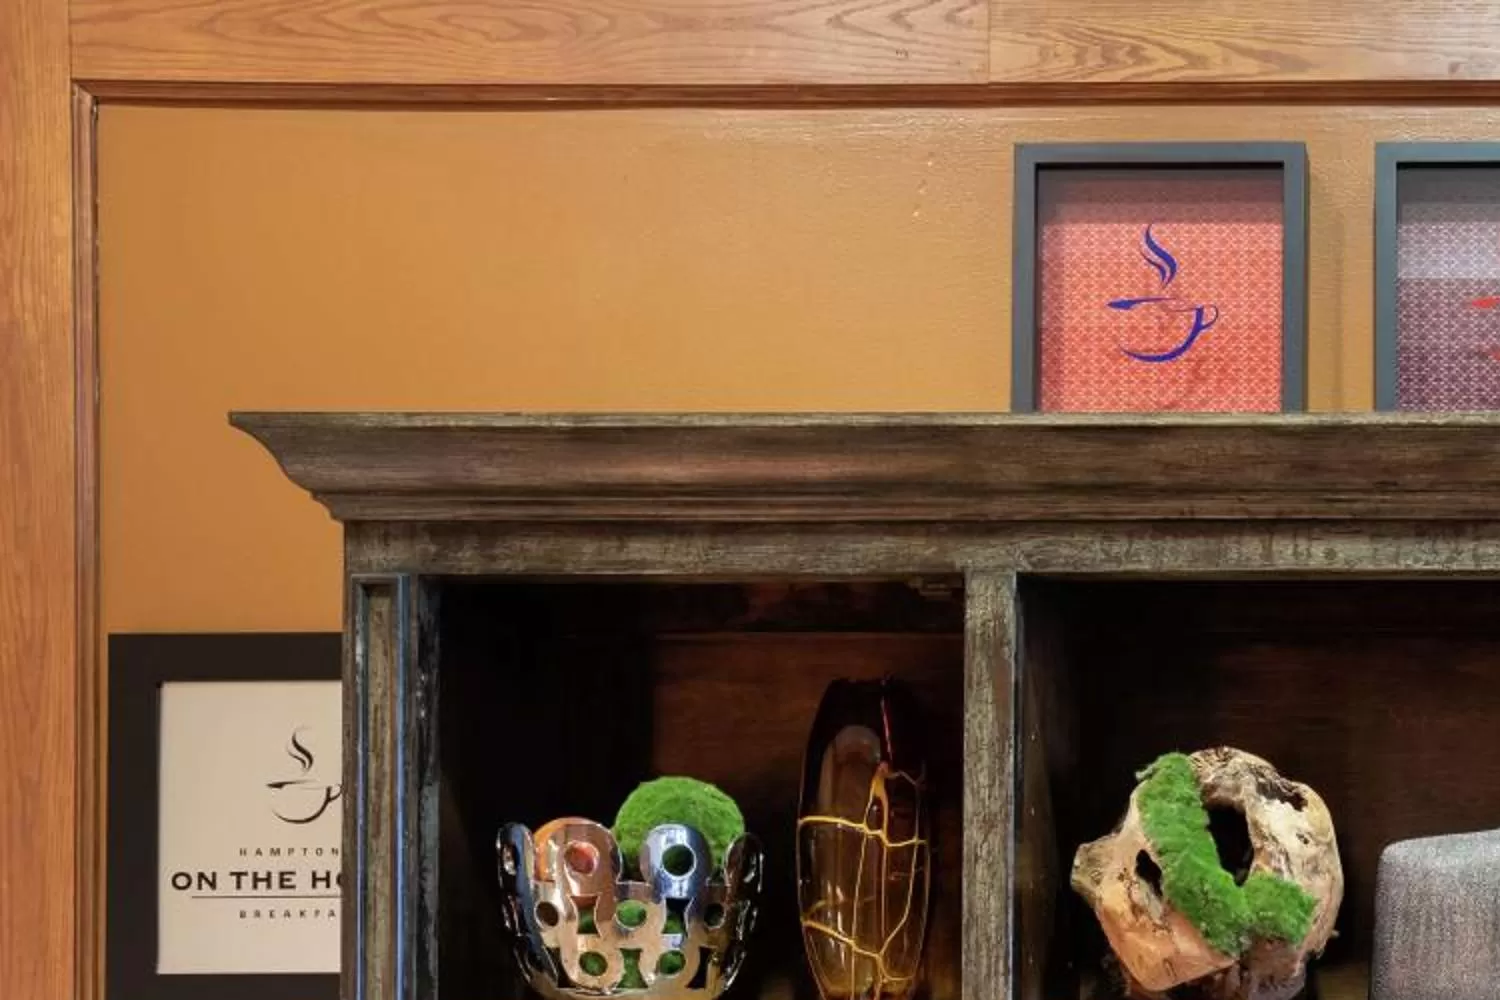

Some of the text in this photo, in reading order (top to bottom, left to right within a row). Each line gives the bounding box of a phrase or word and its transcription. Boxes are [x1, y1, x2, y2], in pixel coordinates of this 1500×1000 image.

[239, 847, 339, 856] HAMPTON
[171, 871, 217, 891] ON
[229, 871, 296, 890] THE
